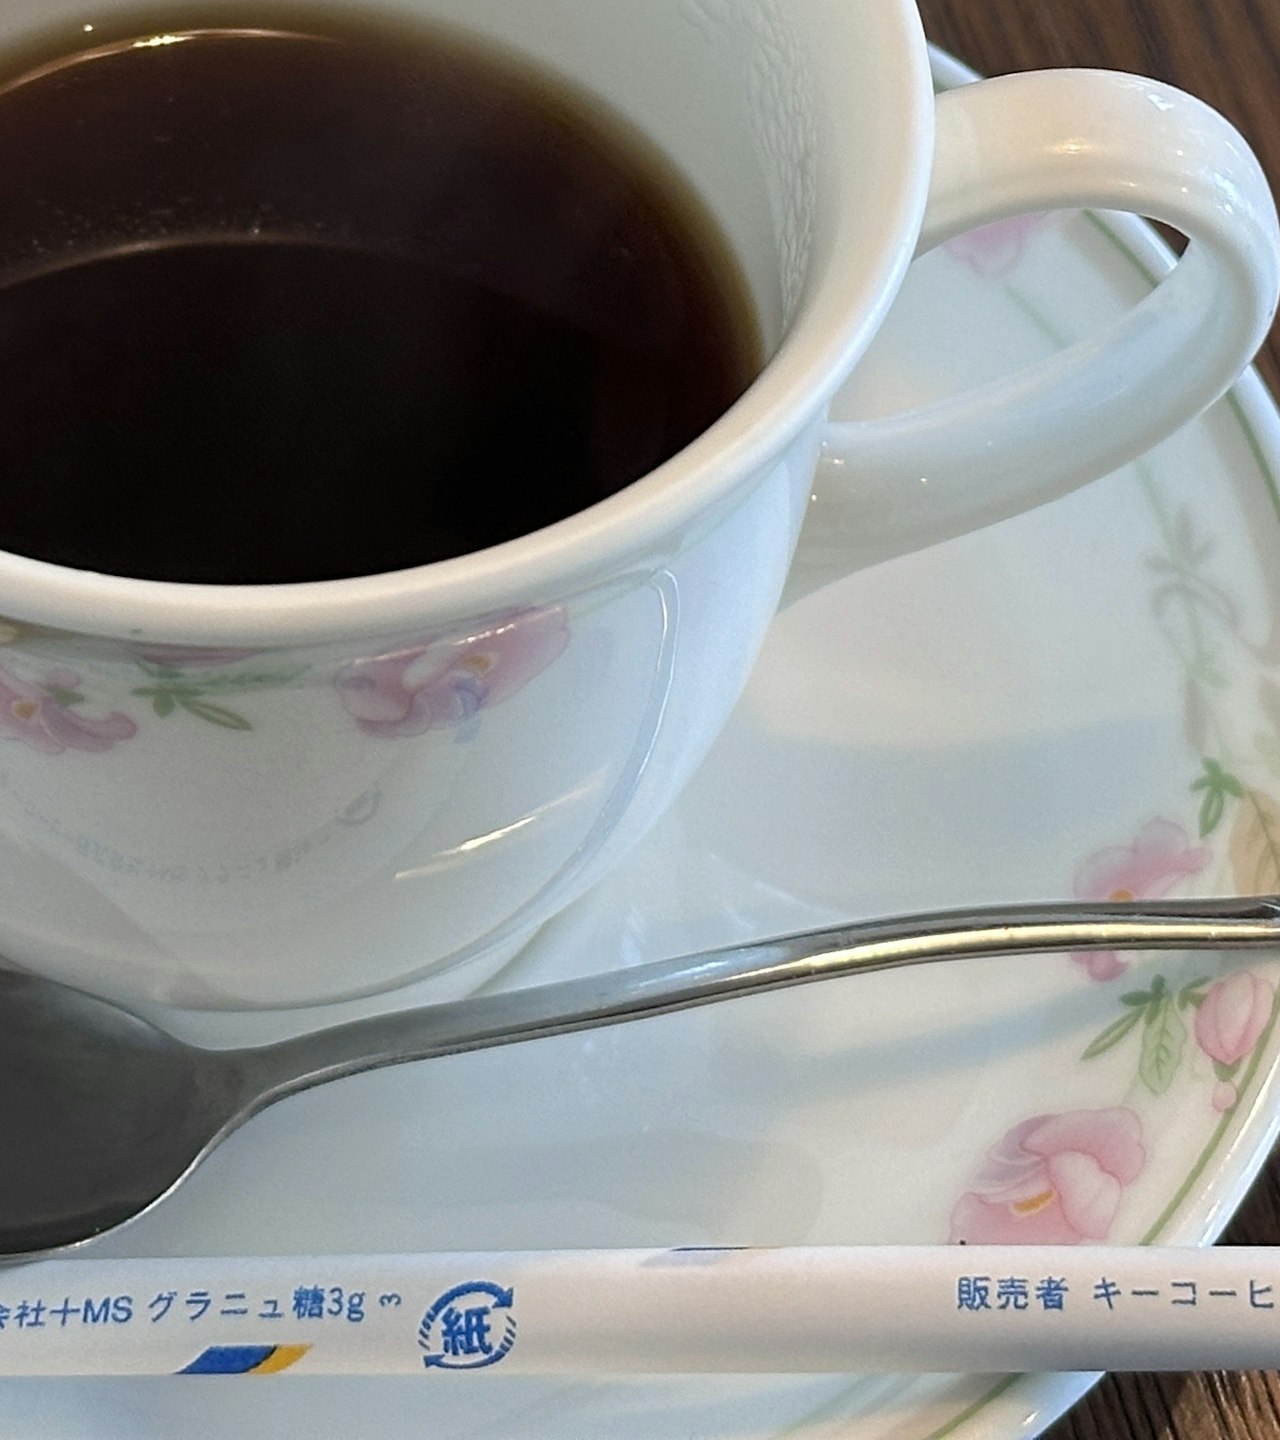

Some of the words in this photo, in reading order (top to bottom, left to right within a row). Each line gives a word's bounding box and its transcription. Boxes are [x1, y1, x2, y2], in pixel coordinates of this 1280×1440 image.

[956, 1275, 1070, 1312] 販売者
[440, 1305, 494, 1356] 紙
